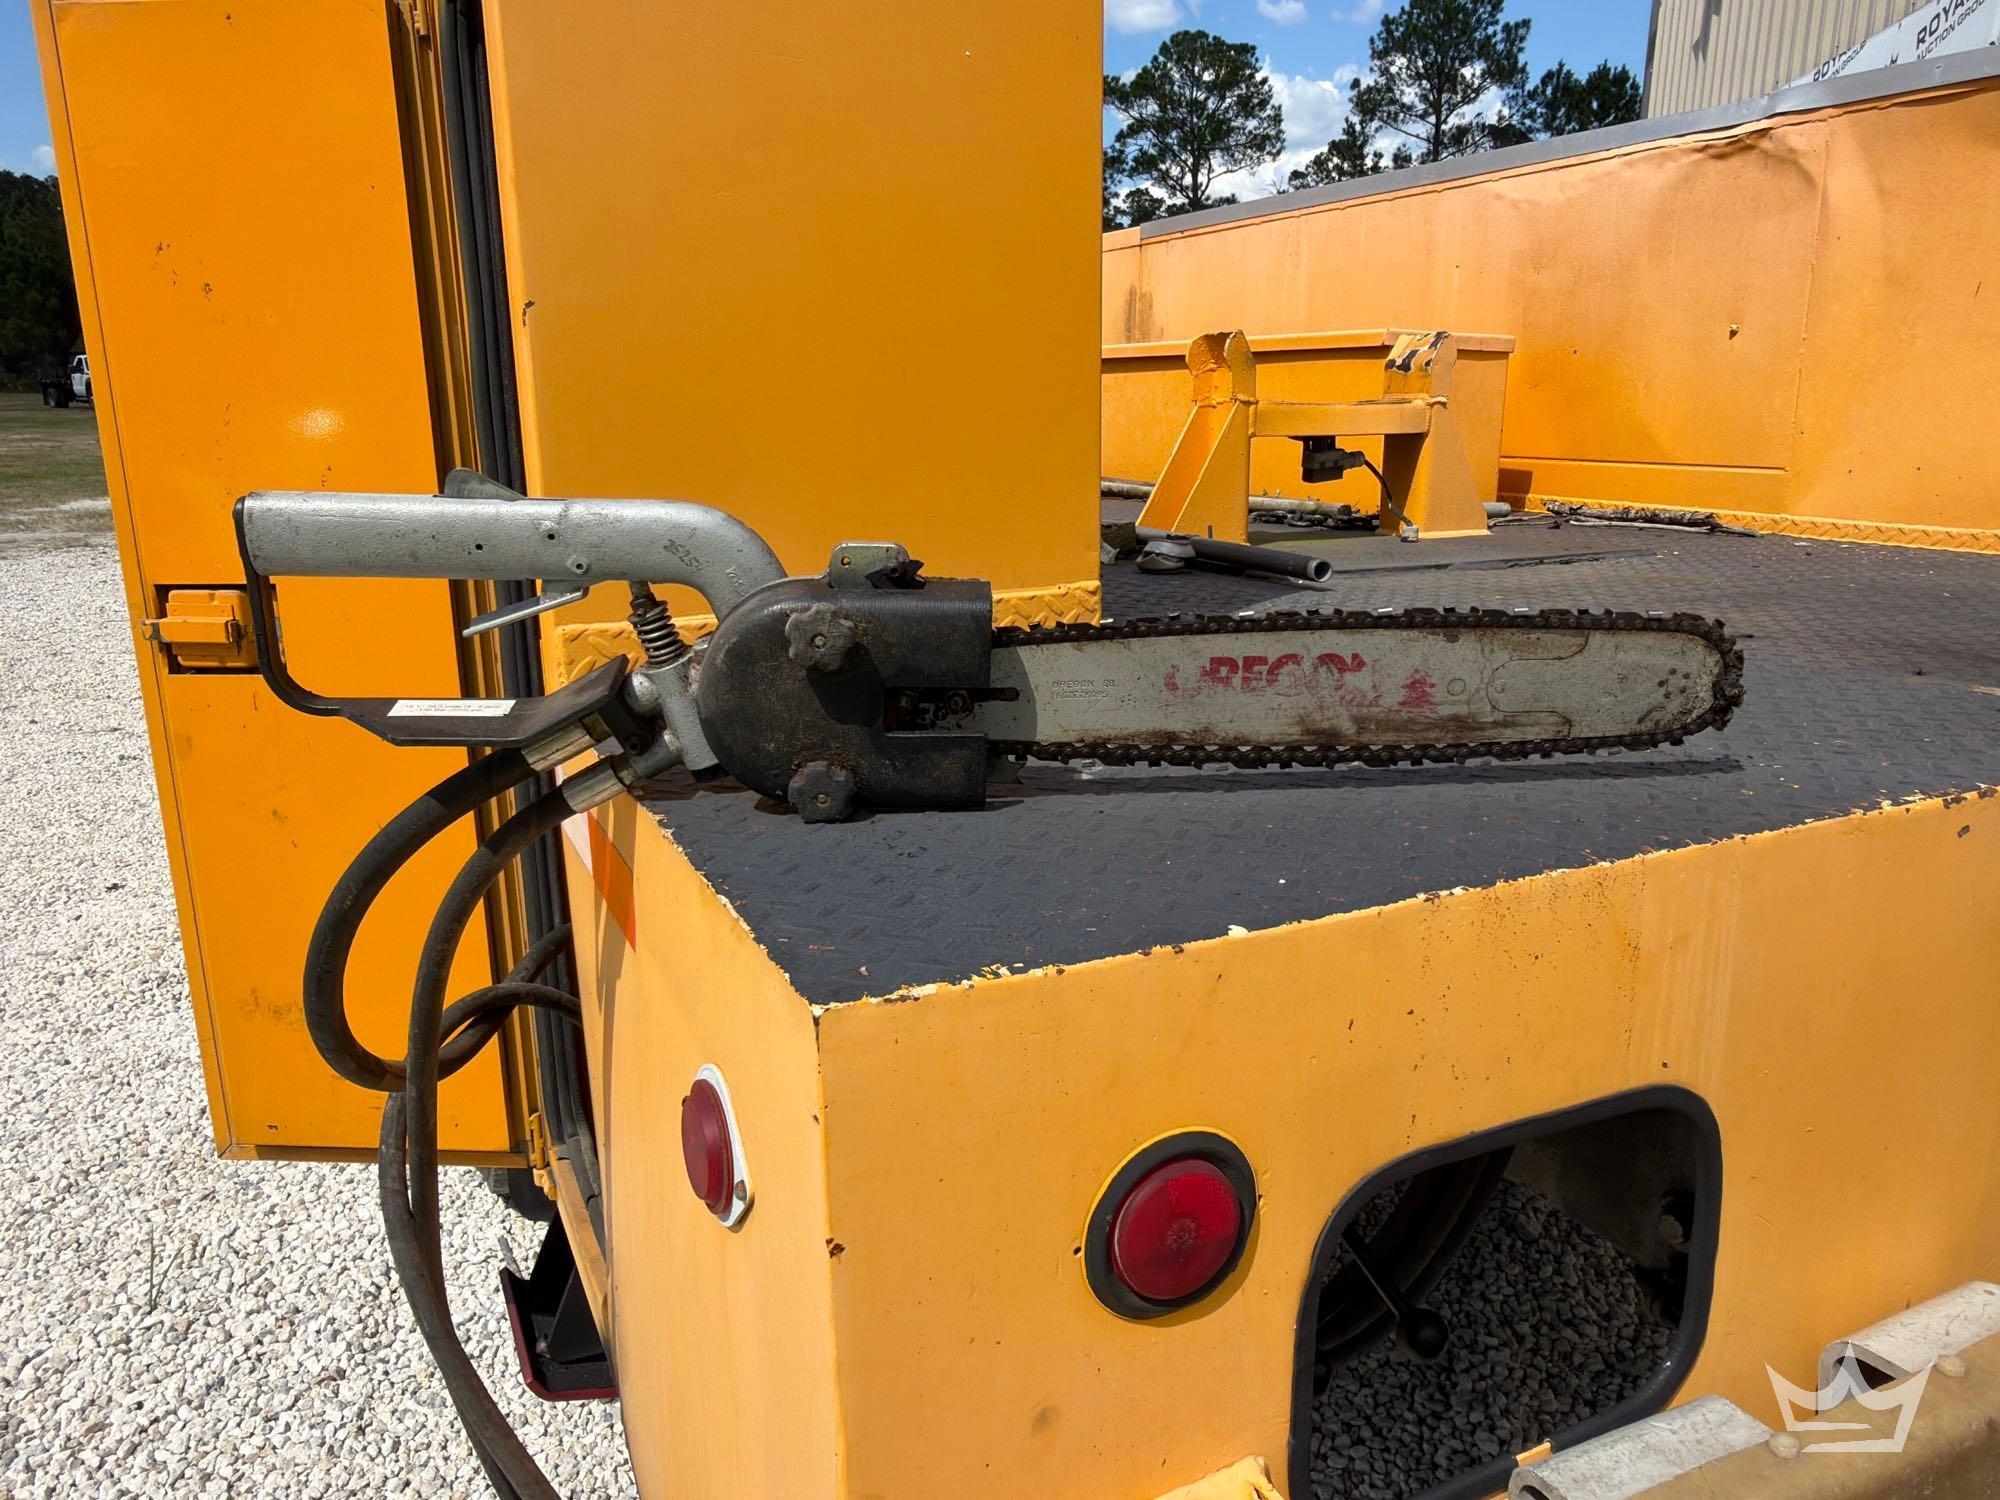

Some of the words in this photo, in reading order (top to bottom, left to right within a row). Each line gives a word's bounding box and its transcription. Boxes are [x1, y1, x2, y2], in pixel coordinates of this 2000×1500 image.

[1916, 0, 1970, 51] ROYA
[1916, 20, 1956, 60] AUCTION
[1957, 0, 1985, 26] GROU
[1813, 48, 1851, 82] ROY
[1840, 39, 1867, 71] GROUP
[1163, 652, 1384, 706] REGO
